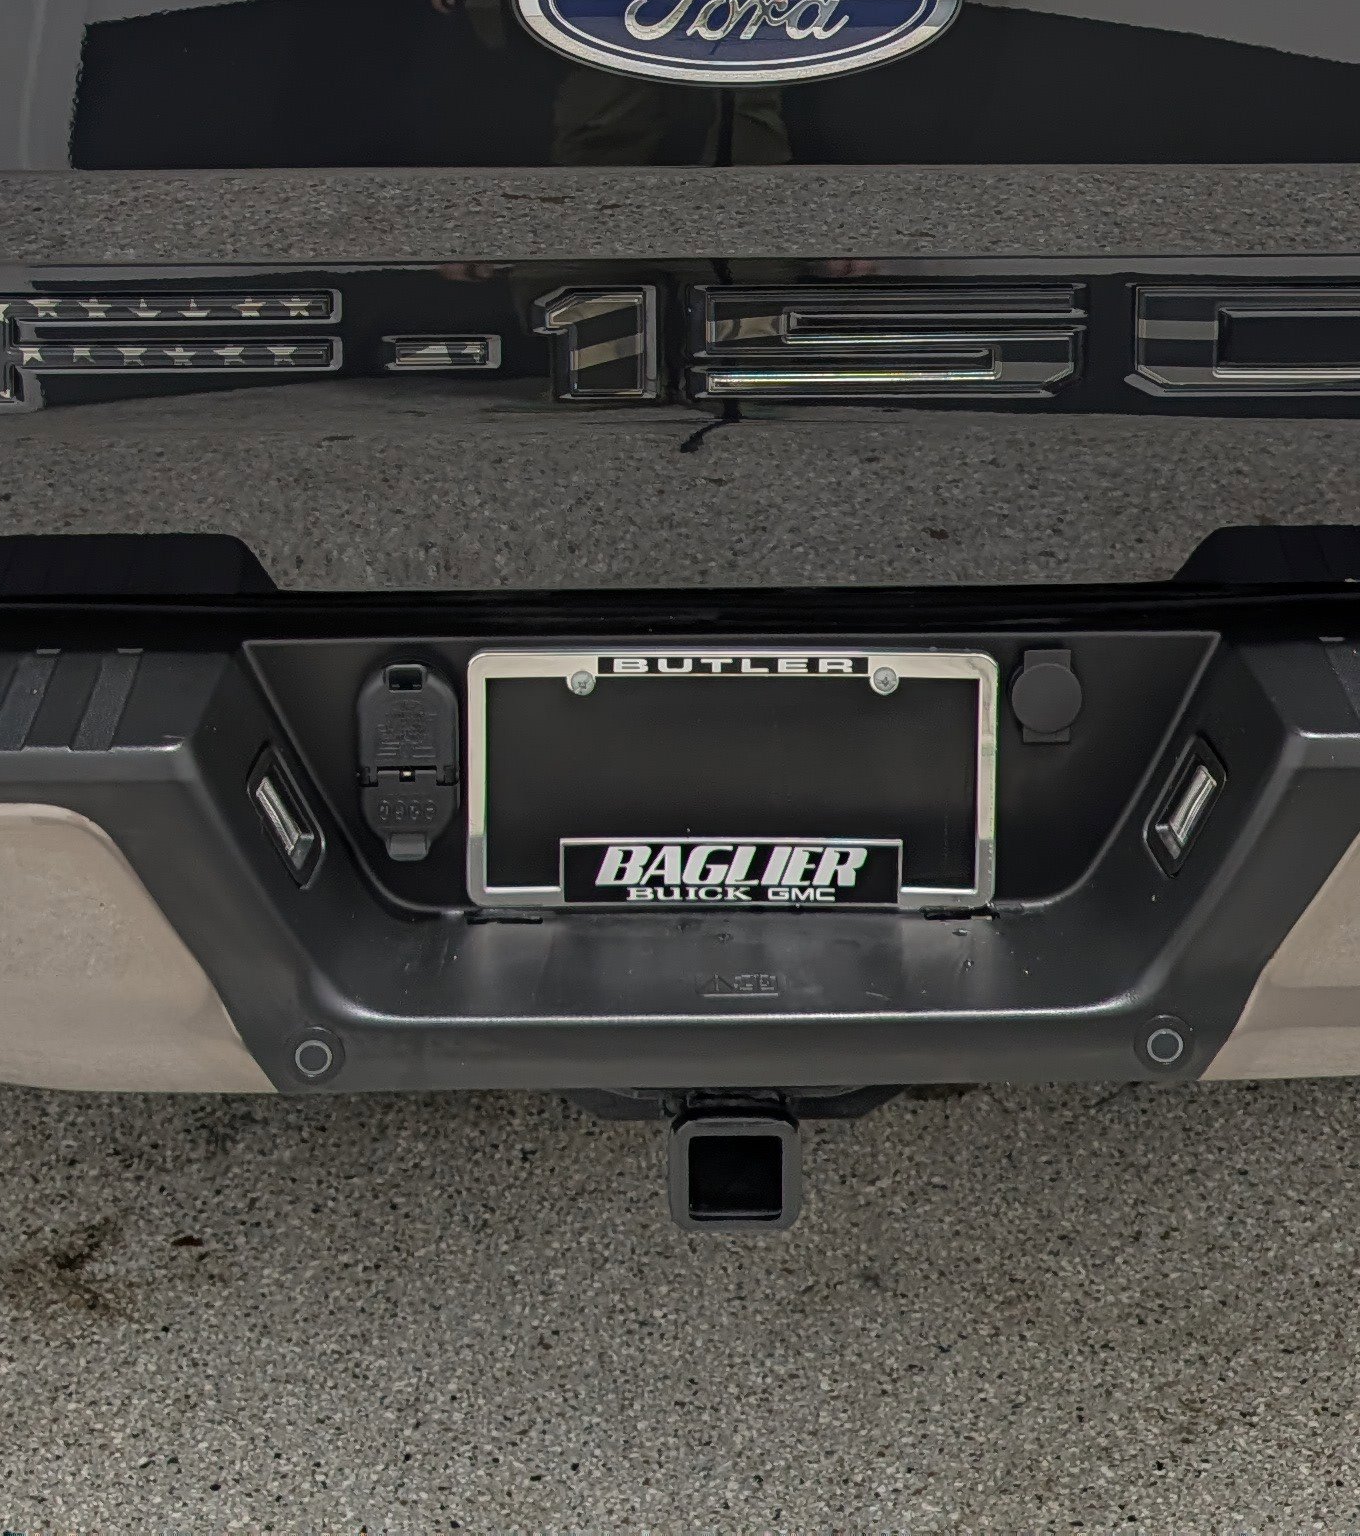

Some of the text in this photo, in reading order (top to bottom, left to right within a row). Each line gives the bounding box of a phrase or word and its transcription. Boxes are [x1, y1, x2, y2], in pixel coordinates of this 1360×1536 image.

[612, 657, 854, 674] BUTLER
[594, 844, 868, 887] BAGLIER
[626, 886, 837, 902] BUICK GMC
